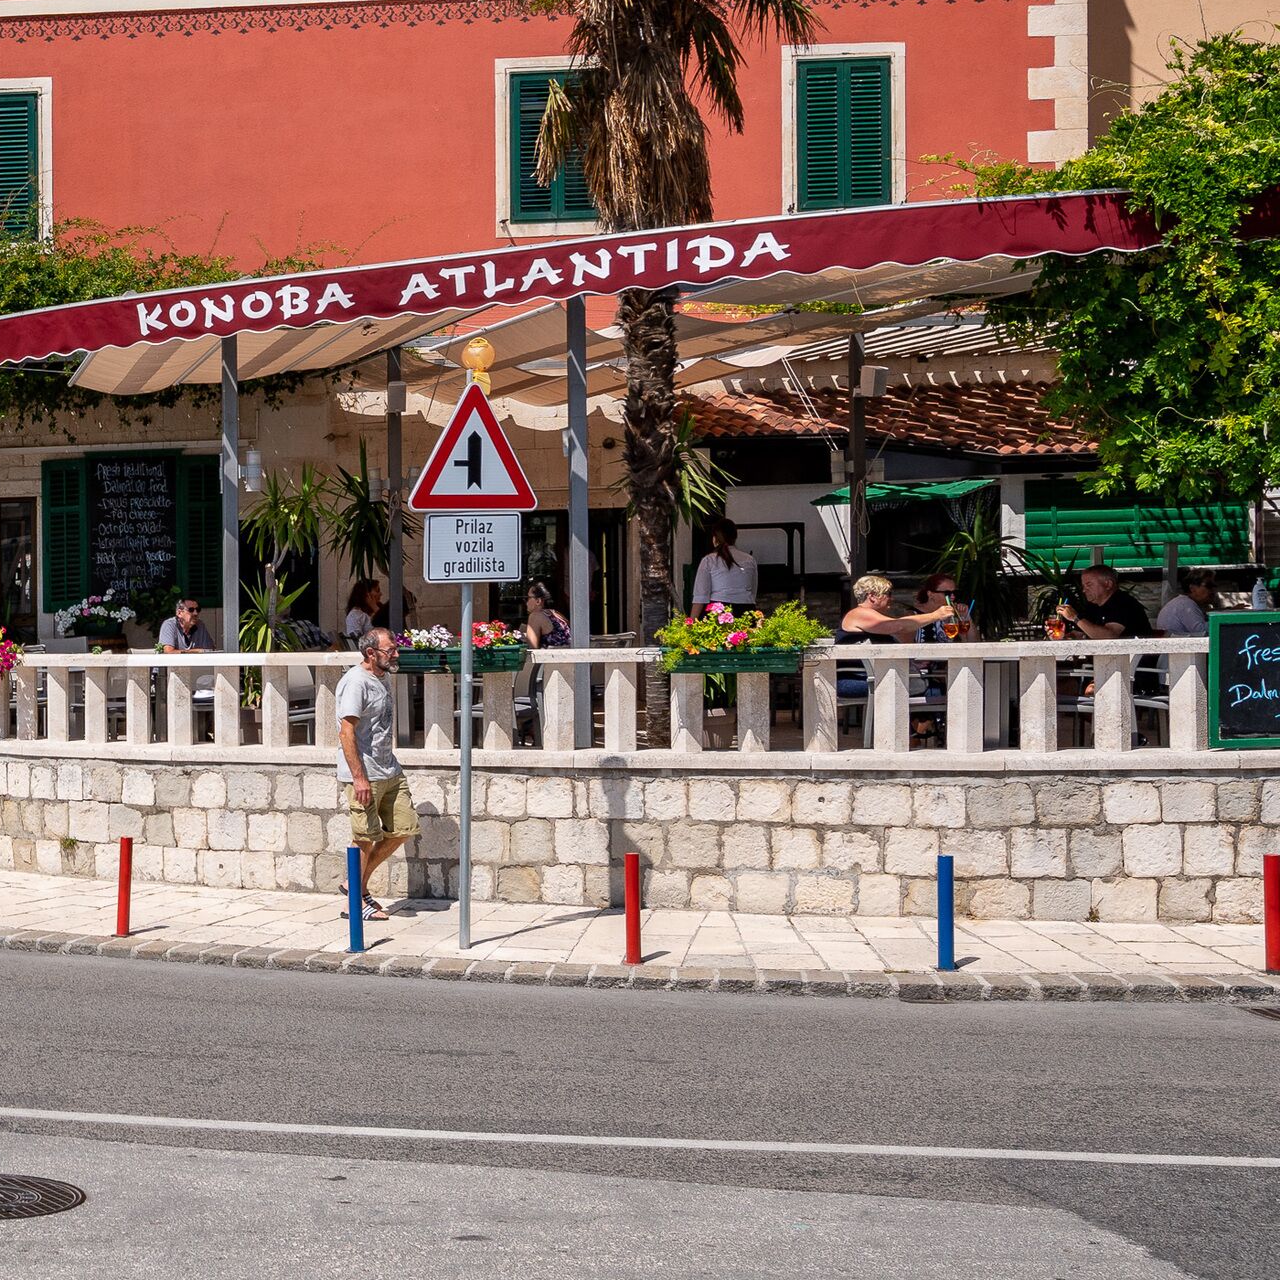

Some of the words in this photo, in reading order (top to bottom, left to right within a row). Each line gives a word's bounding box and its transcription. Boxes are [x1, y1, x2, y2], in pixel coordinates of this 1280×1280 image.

[135, 282, 355, 339] KONOBA
[399, 231, 791, 307] ATLANTIDA
[455, 518, 493, 534] Prilaz
[455, 537, 494, 553] vozila
[443, 556, 505, 578] gradilišta
[1228, 678, 1280, 708] Dalm
